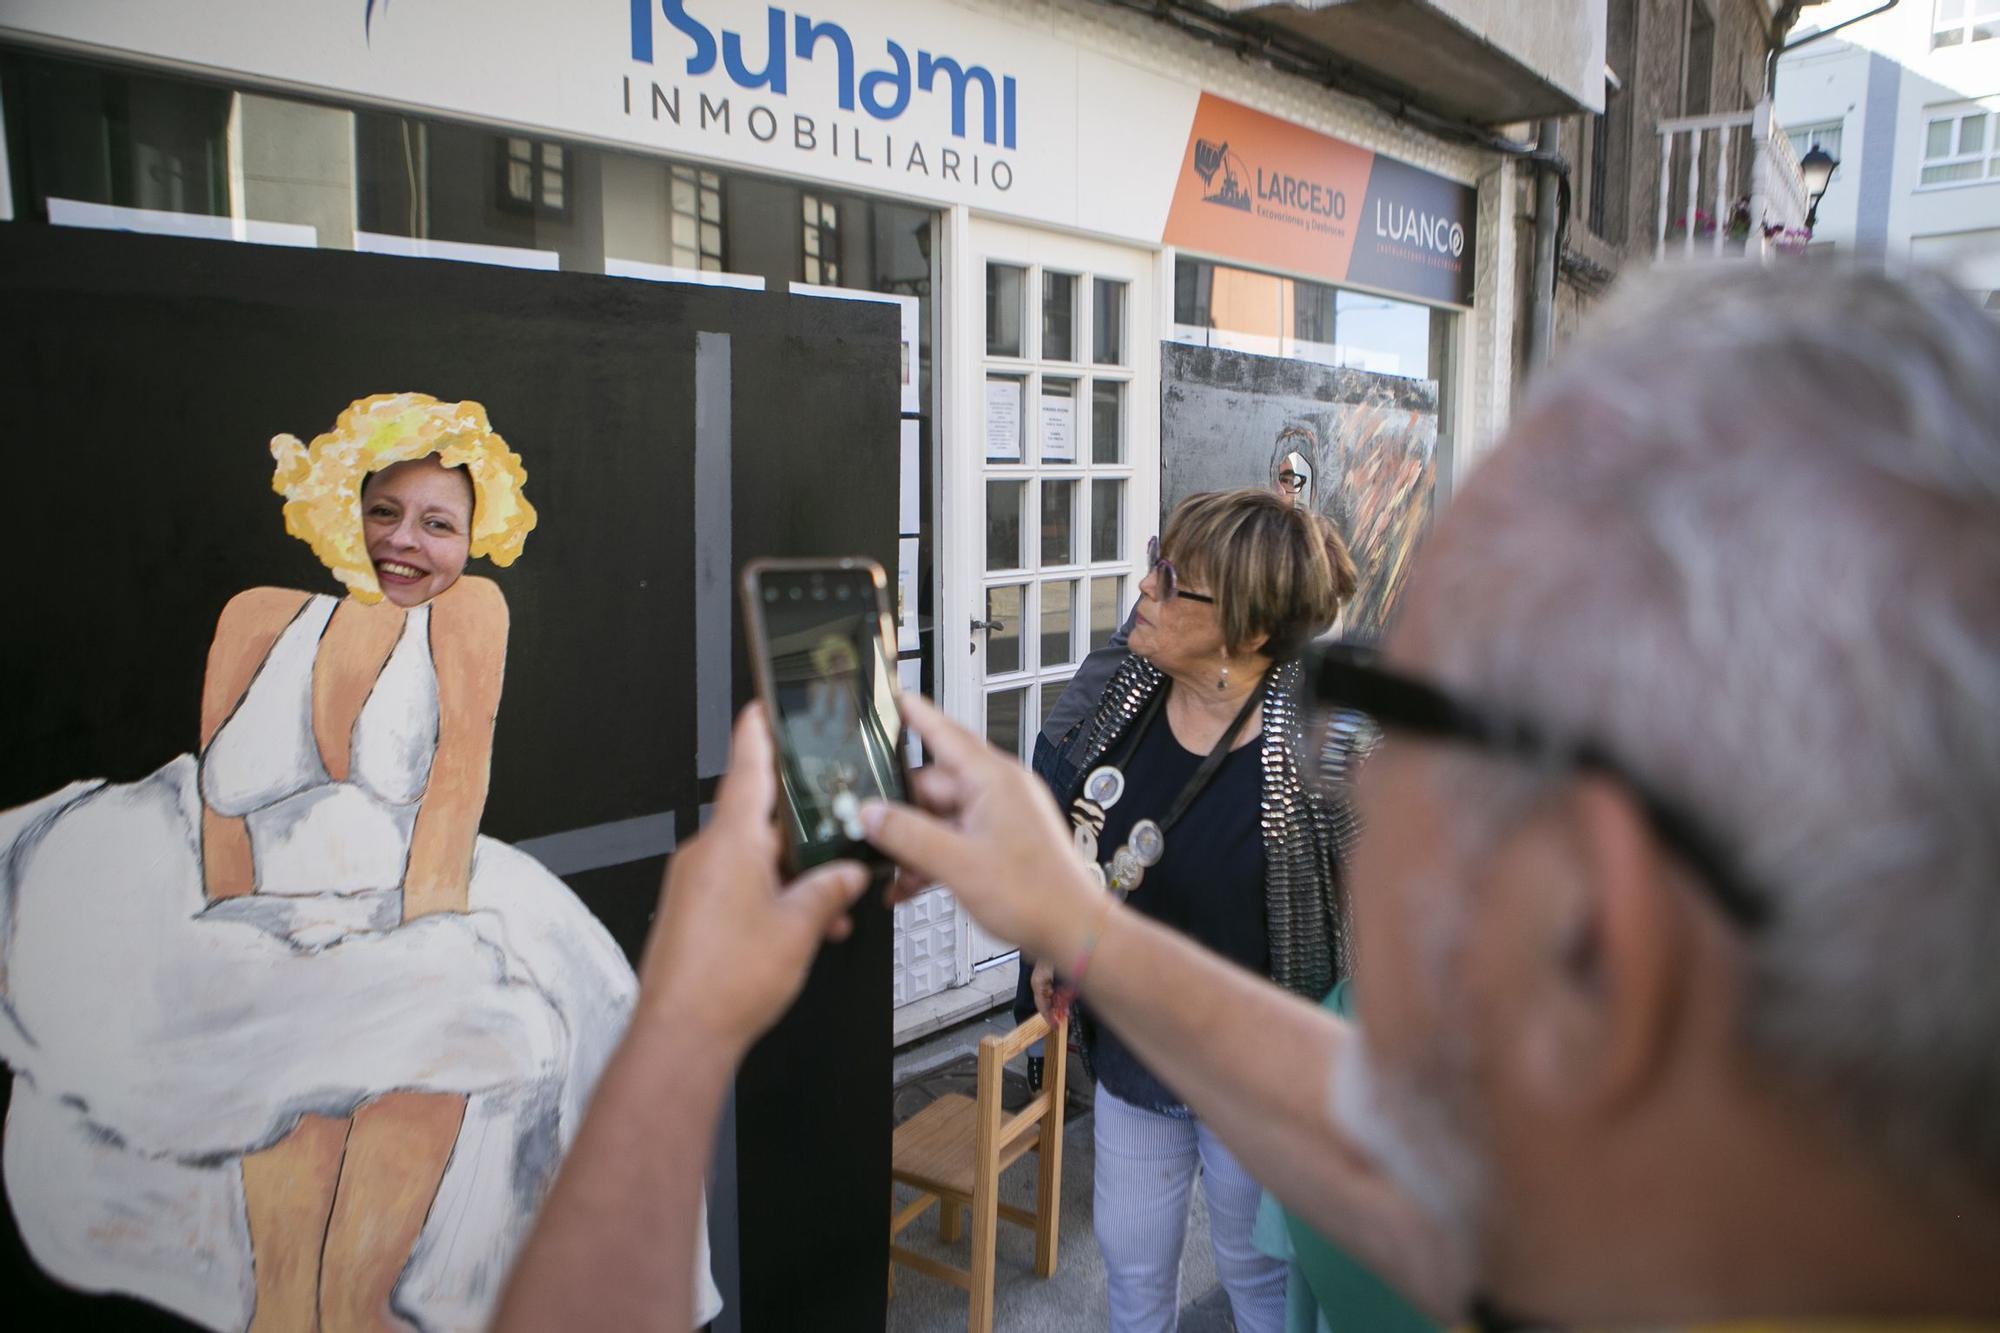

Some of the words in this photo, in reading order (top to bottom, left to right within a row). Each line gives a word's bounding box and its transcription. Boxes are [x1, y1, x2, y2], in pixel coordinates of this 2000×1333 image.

[623, 76, 1014, 191] INMOBILIARIO
[1257, 168, 1346, 220] LARCEJO
[1376, 197, 1464, 257] LUANCO
